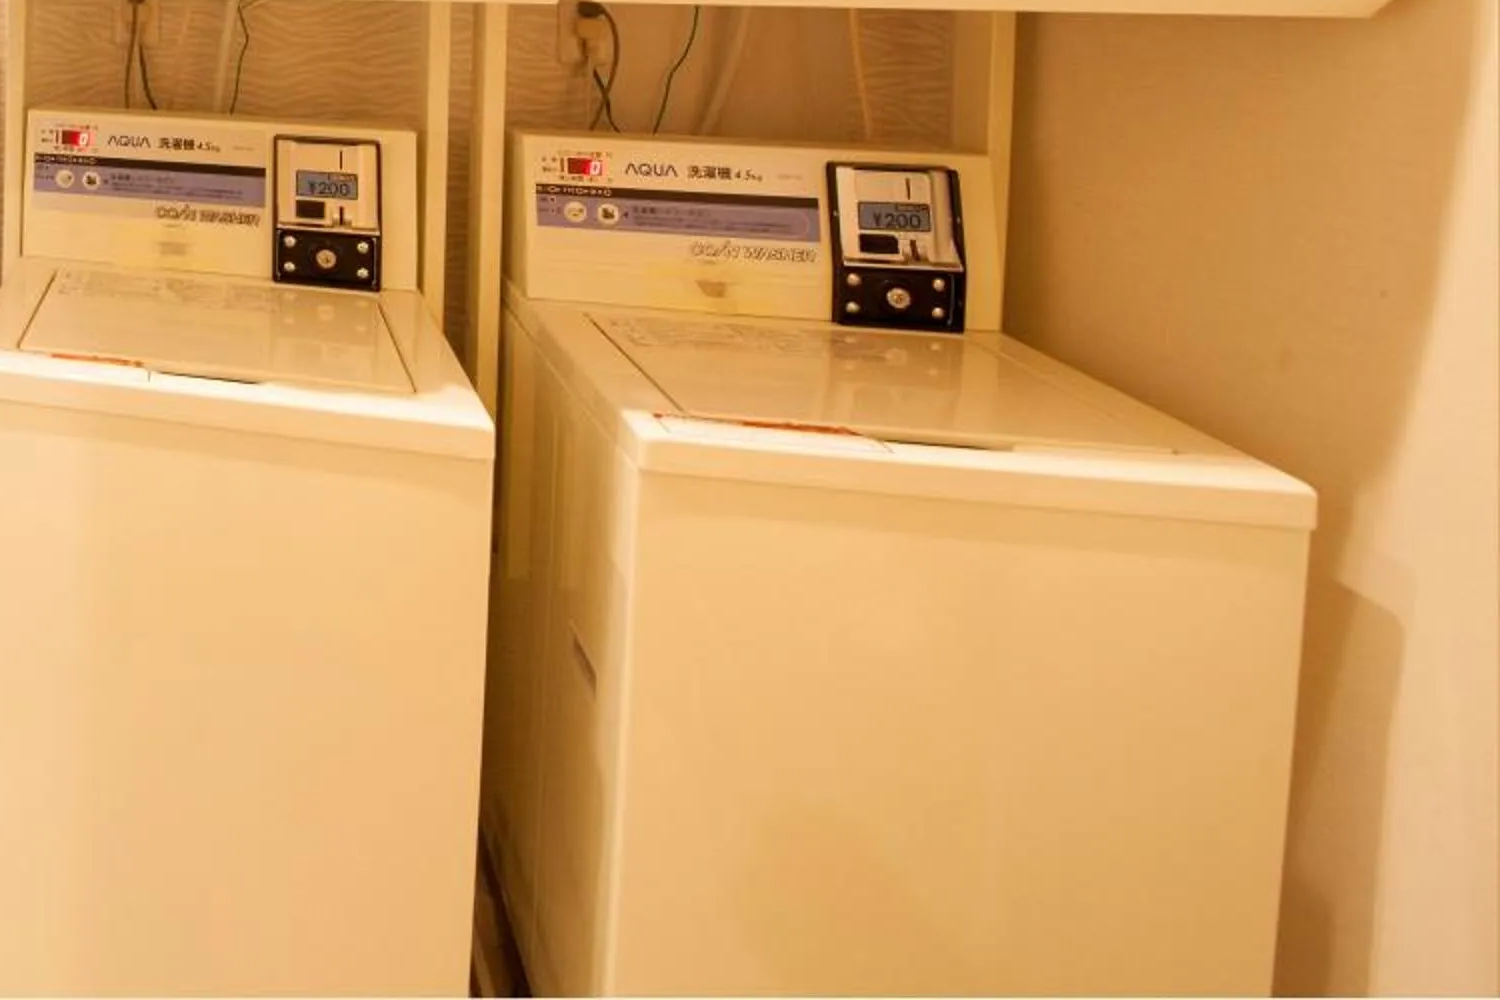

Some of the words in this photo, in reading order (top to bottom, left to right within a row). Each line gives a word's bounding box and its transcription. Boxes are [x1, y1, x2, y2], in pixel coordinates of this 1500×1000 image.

[108, 135, 151, 149] AQUA
[625, 163, 678, 178] AQUA
[873, 211, 922, 230] ¥200
